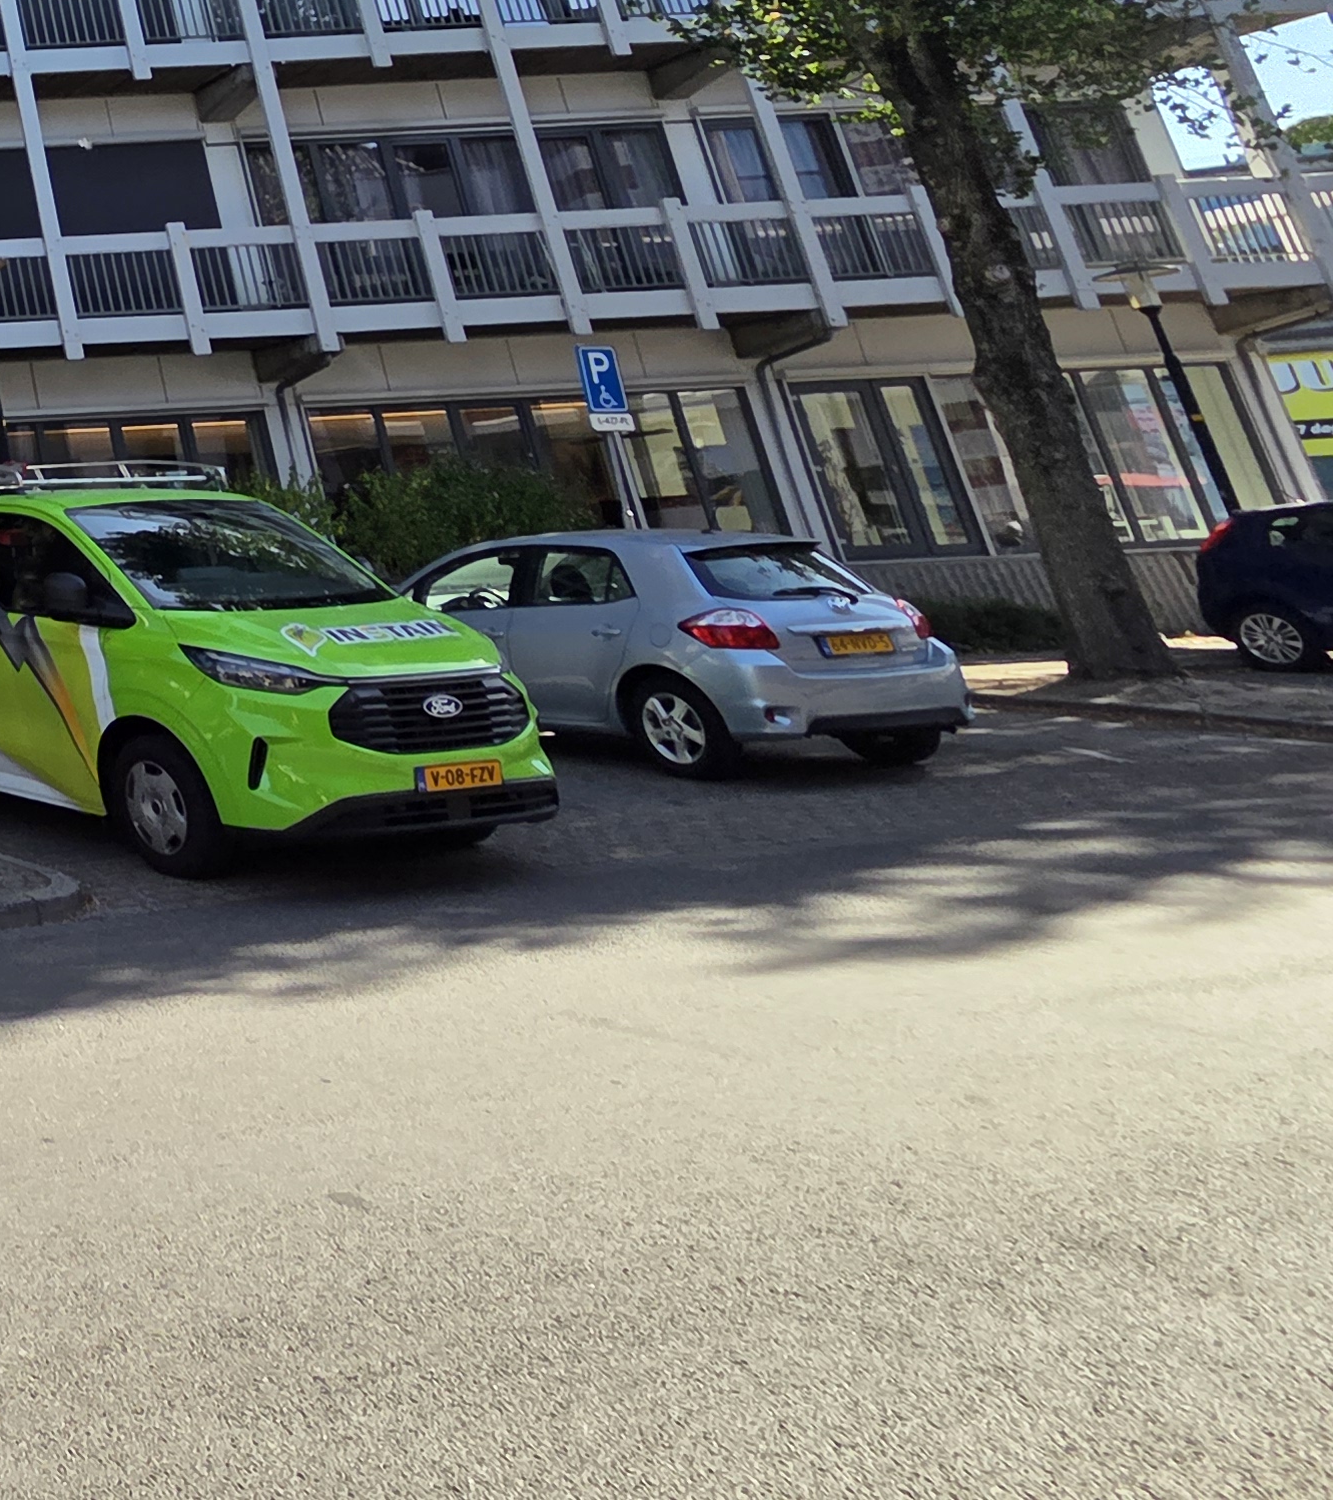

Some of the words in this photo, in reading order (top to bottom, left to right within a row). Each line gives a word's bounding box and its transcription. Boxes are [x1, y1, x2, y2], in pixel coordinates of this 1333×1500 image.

[587, 352, 610, 384] P
[326, 619, 456, 642] INSTAIN
[430, 765, 496, 788] V-08-FZV
